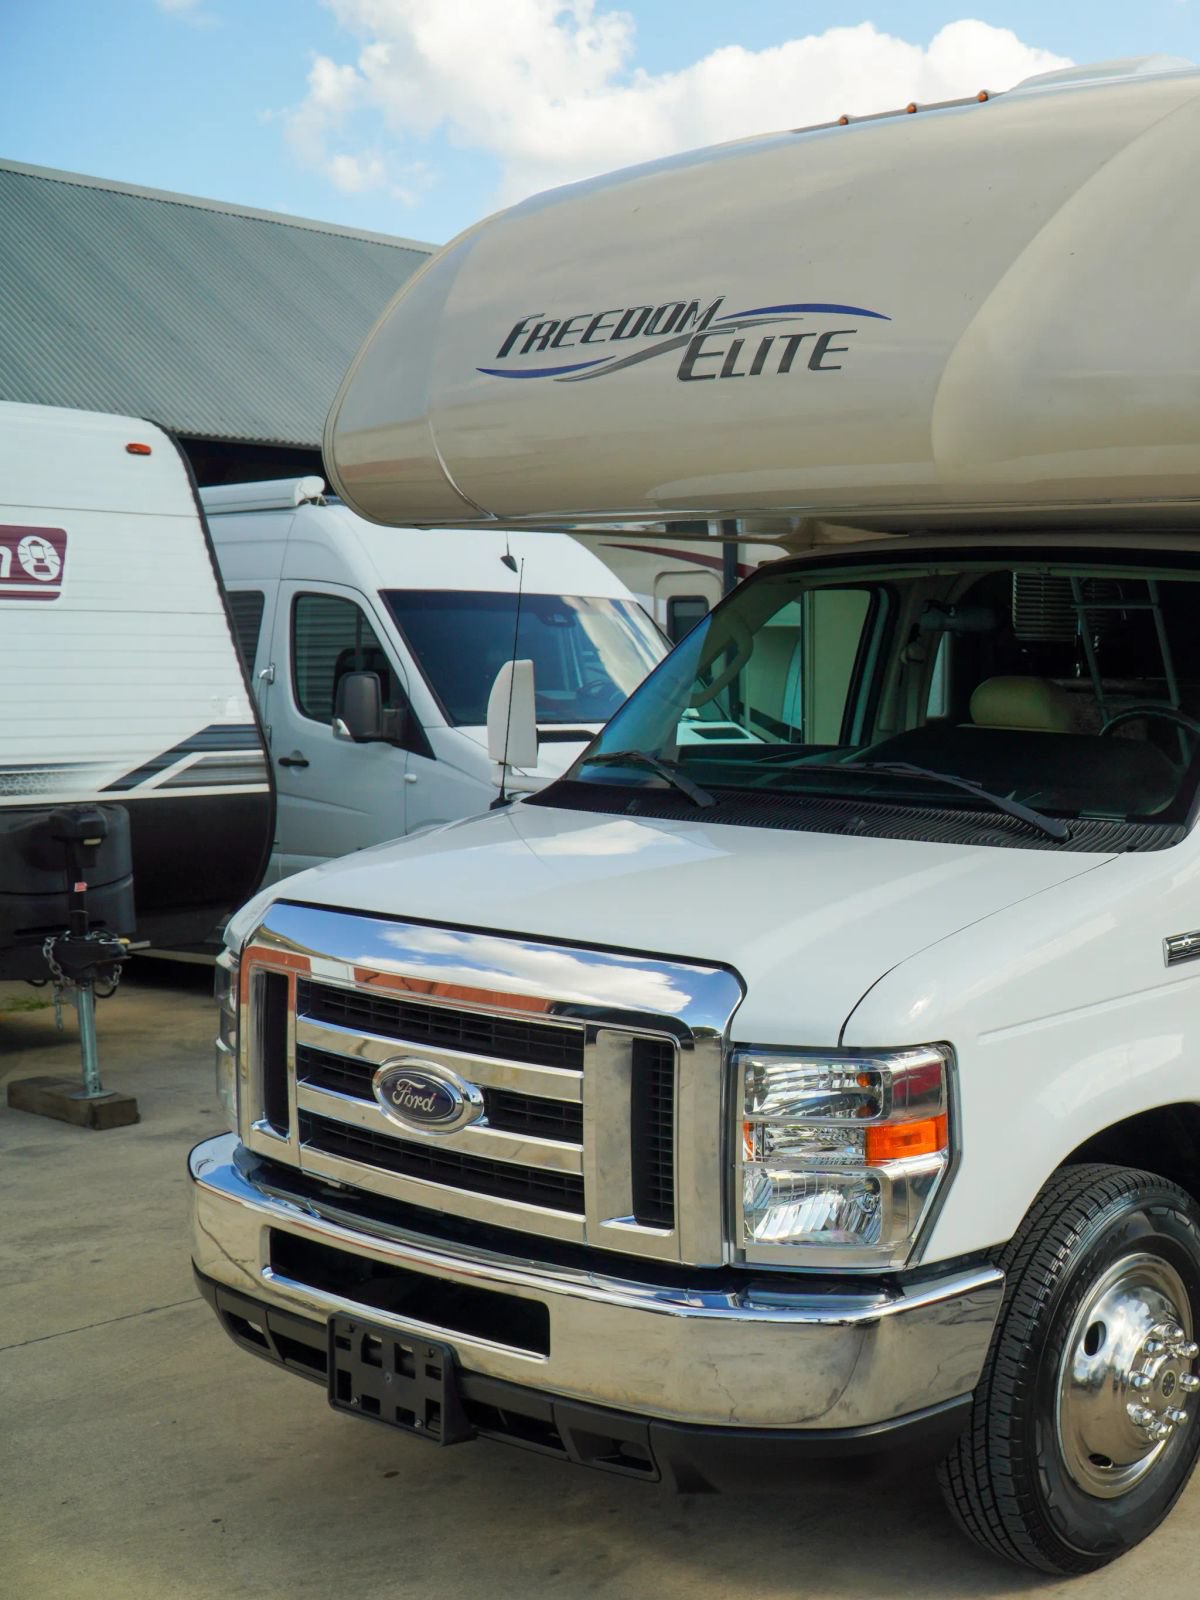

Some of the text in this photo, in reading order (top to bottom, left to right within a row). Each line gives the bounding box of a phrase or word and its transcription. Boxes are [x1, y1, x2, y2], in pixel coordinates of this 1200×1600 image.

[495, 296, 727, 359] FREEDOM
[677, 328, 859, 382] ELITE
[391, 1078, 438, 1112] Ford
